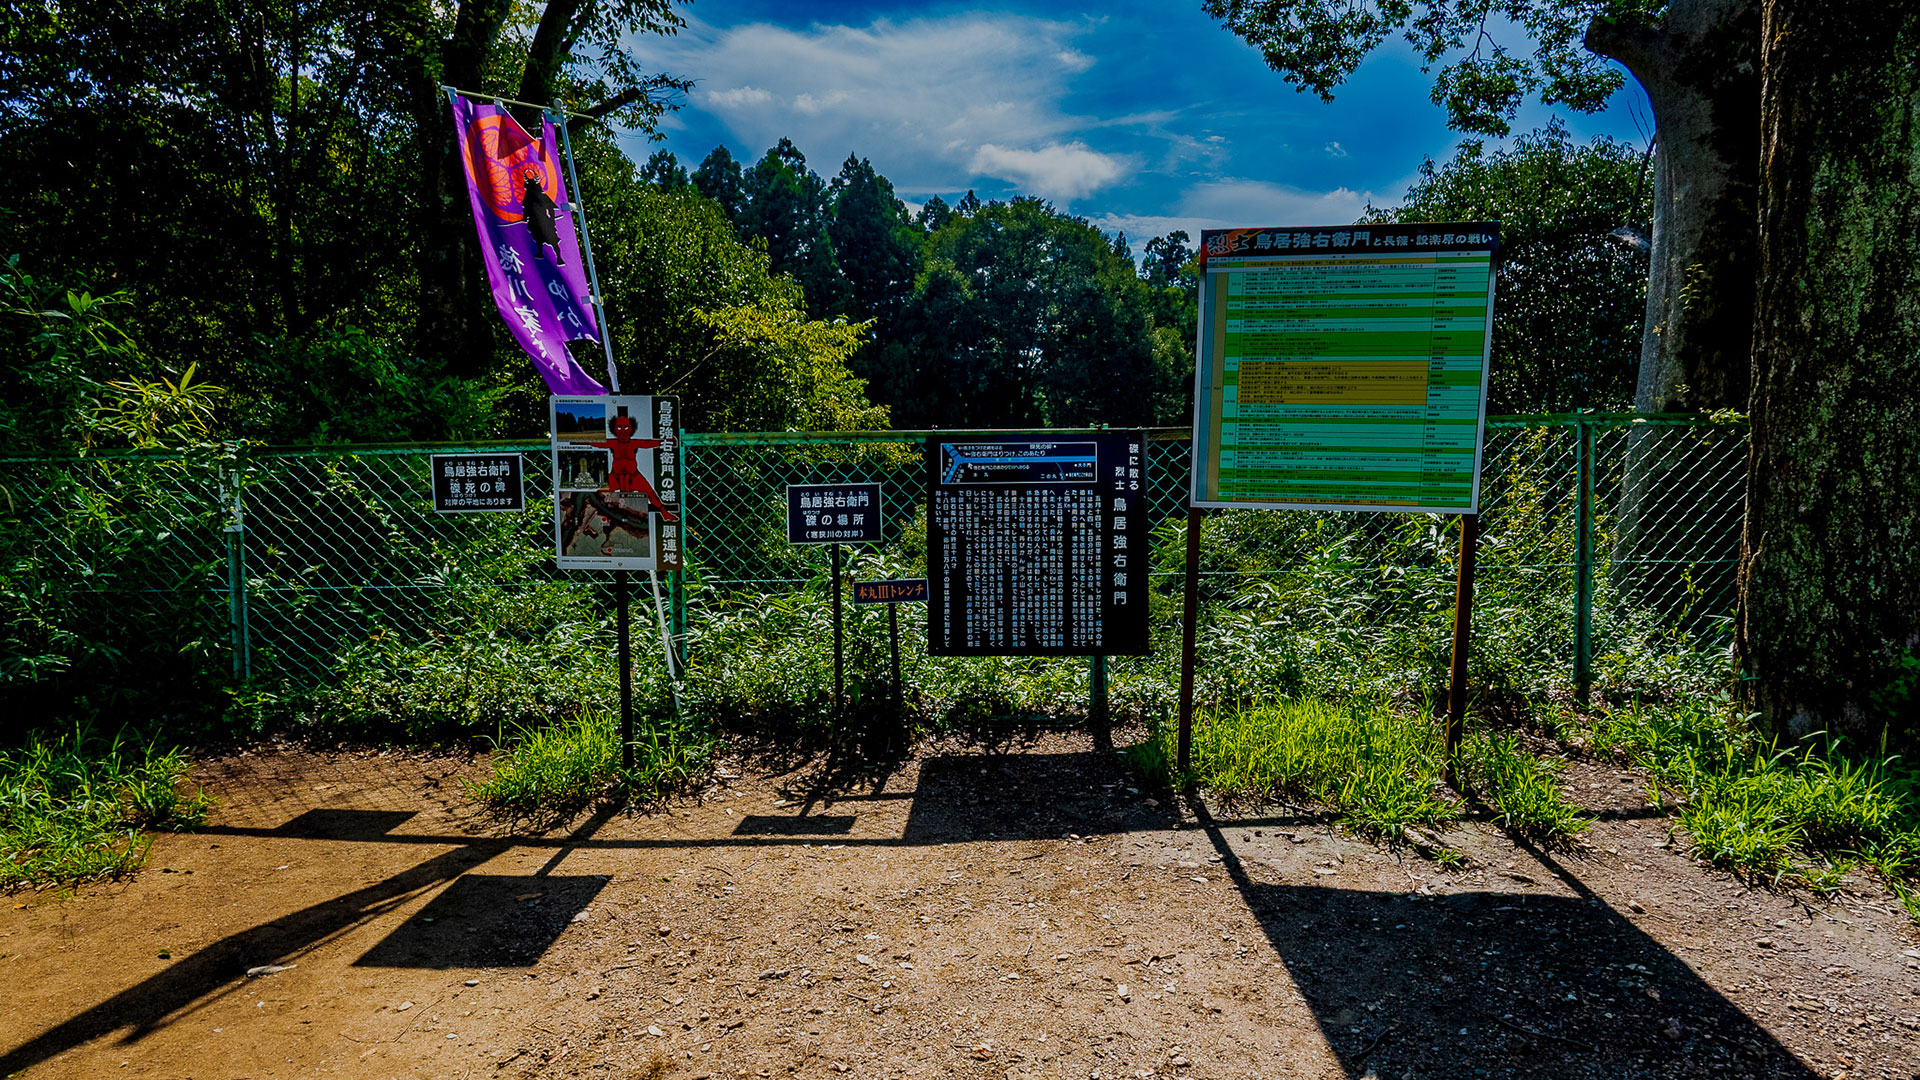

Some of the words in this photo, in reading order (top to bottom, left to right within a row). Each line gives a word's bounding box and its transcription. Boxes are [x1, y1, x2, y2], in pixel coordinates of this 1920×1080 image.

[658, 400, 677, 502] 鳥居強右衛門の磔
[444, 465, 511, 478] 鳥居強右衛門
[1114, 466, 1126, 491] 烈士
[449, 481, 507, 495] 磔死の碑
[444, 497, 513, 507] 対岸の平地にあります
[800, 495, 869, 509] 鳥居強右衛門
[805, 513, 865, 527] 磔の場所
[662, 524, 679, 565] 関連地
[1113, 497, 1128, 606] 鳥居強右衛門
